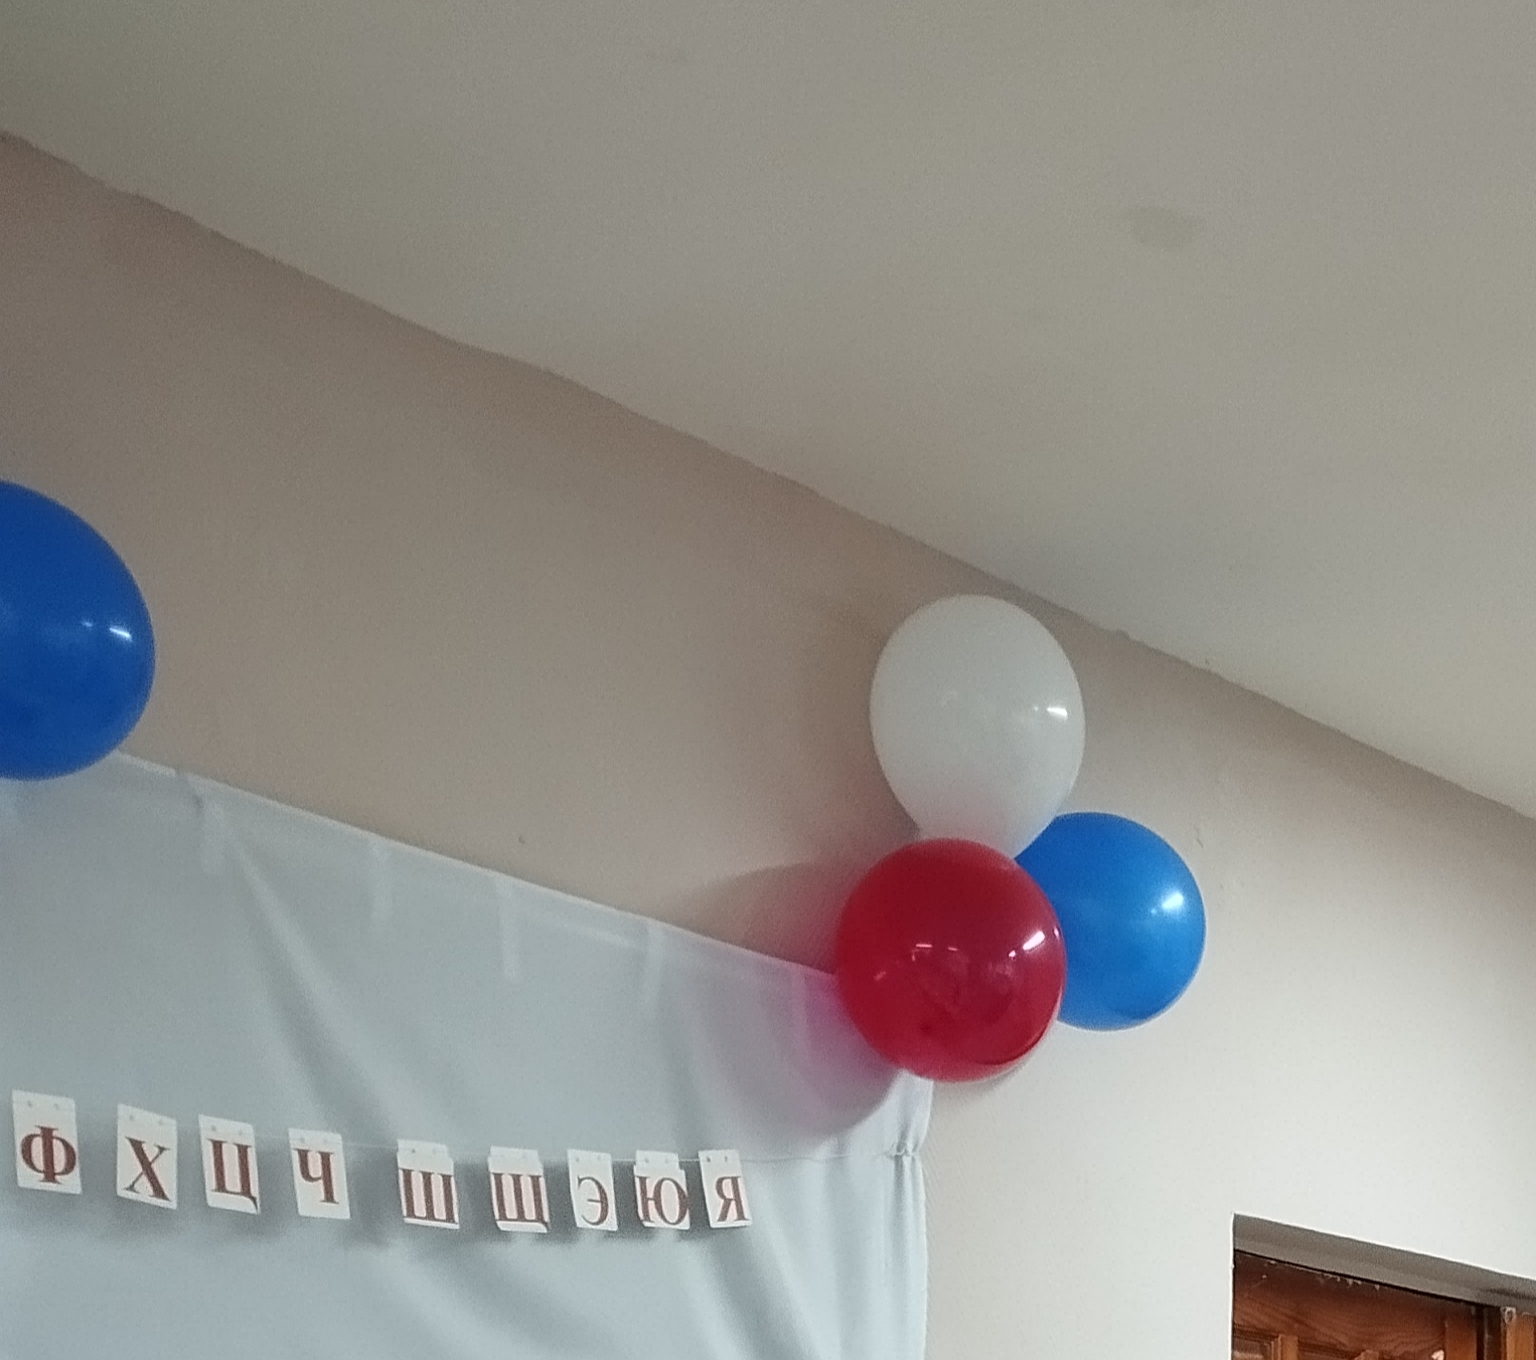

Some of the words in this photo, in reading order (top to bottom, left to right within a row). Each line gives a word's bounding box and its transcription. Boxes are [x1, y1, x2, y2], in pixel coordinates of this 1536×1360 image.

[20, 1125, 77, 1185] Ф
[124, 1136, 172, 1202] Х
[207, 1138, 260, 1213] Ц
[294, 1148, 340, 1204] Ч
[399, 1168, 456, 1224] Ш
[577, 1176, 609, 1226] Э
[635, 1176, 690, 1226] Ю
[715, 1176, 750, 1223] Я
